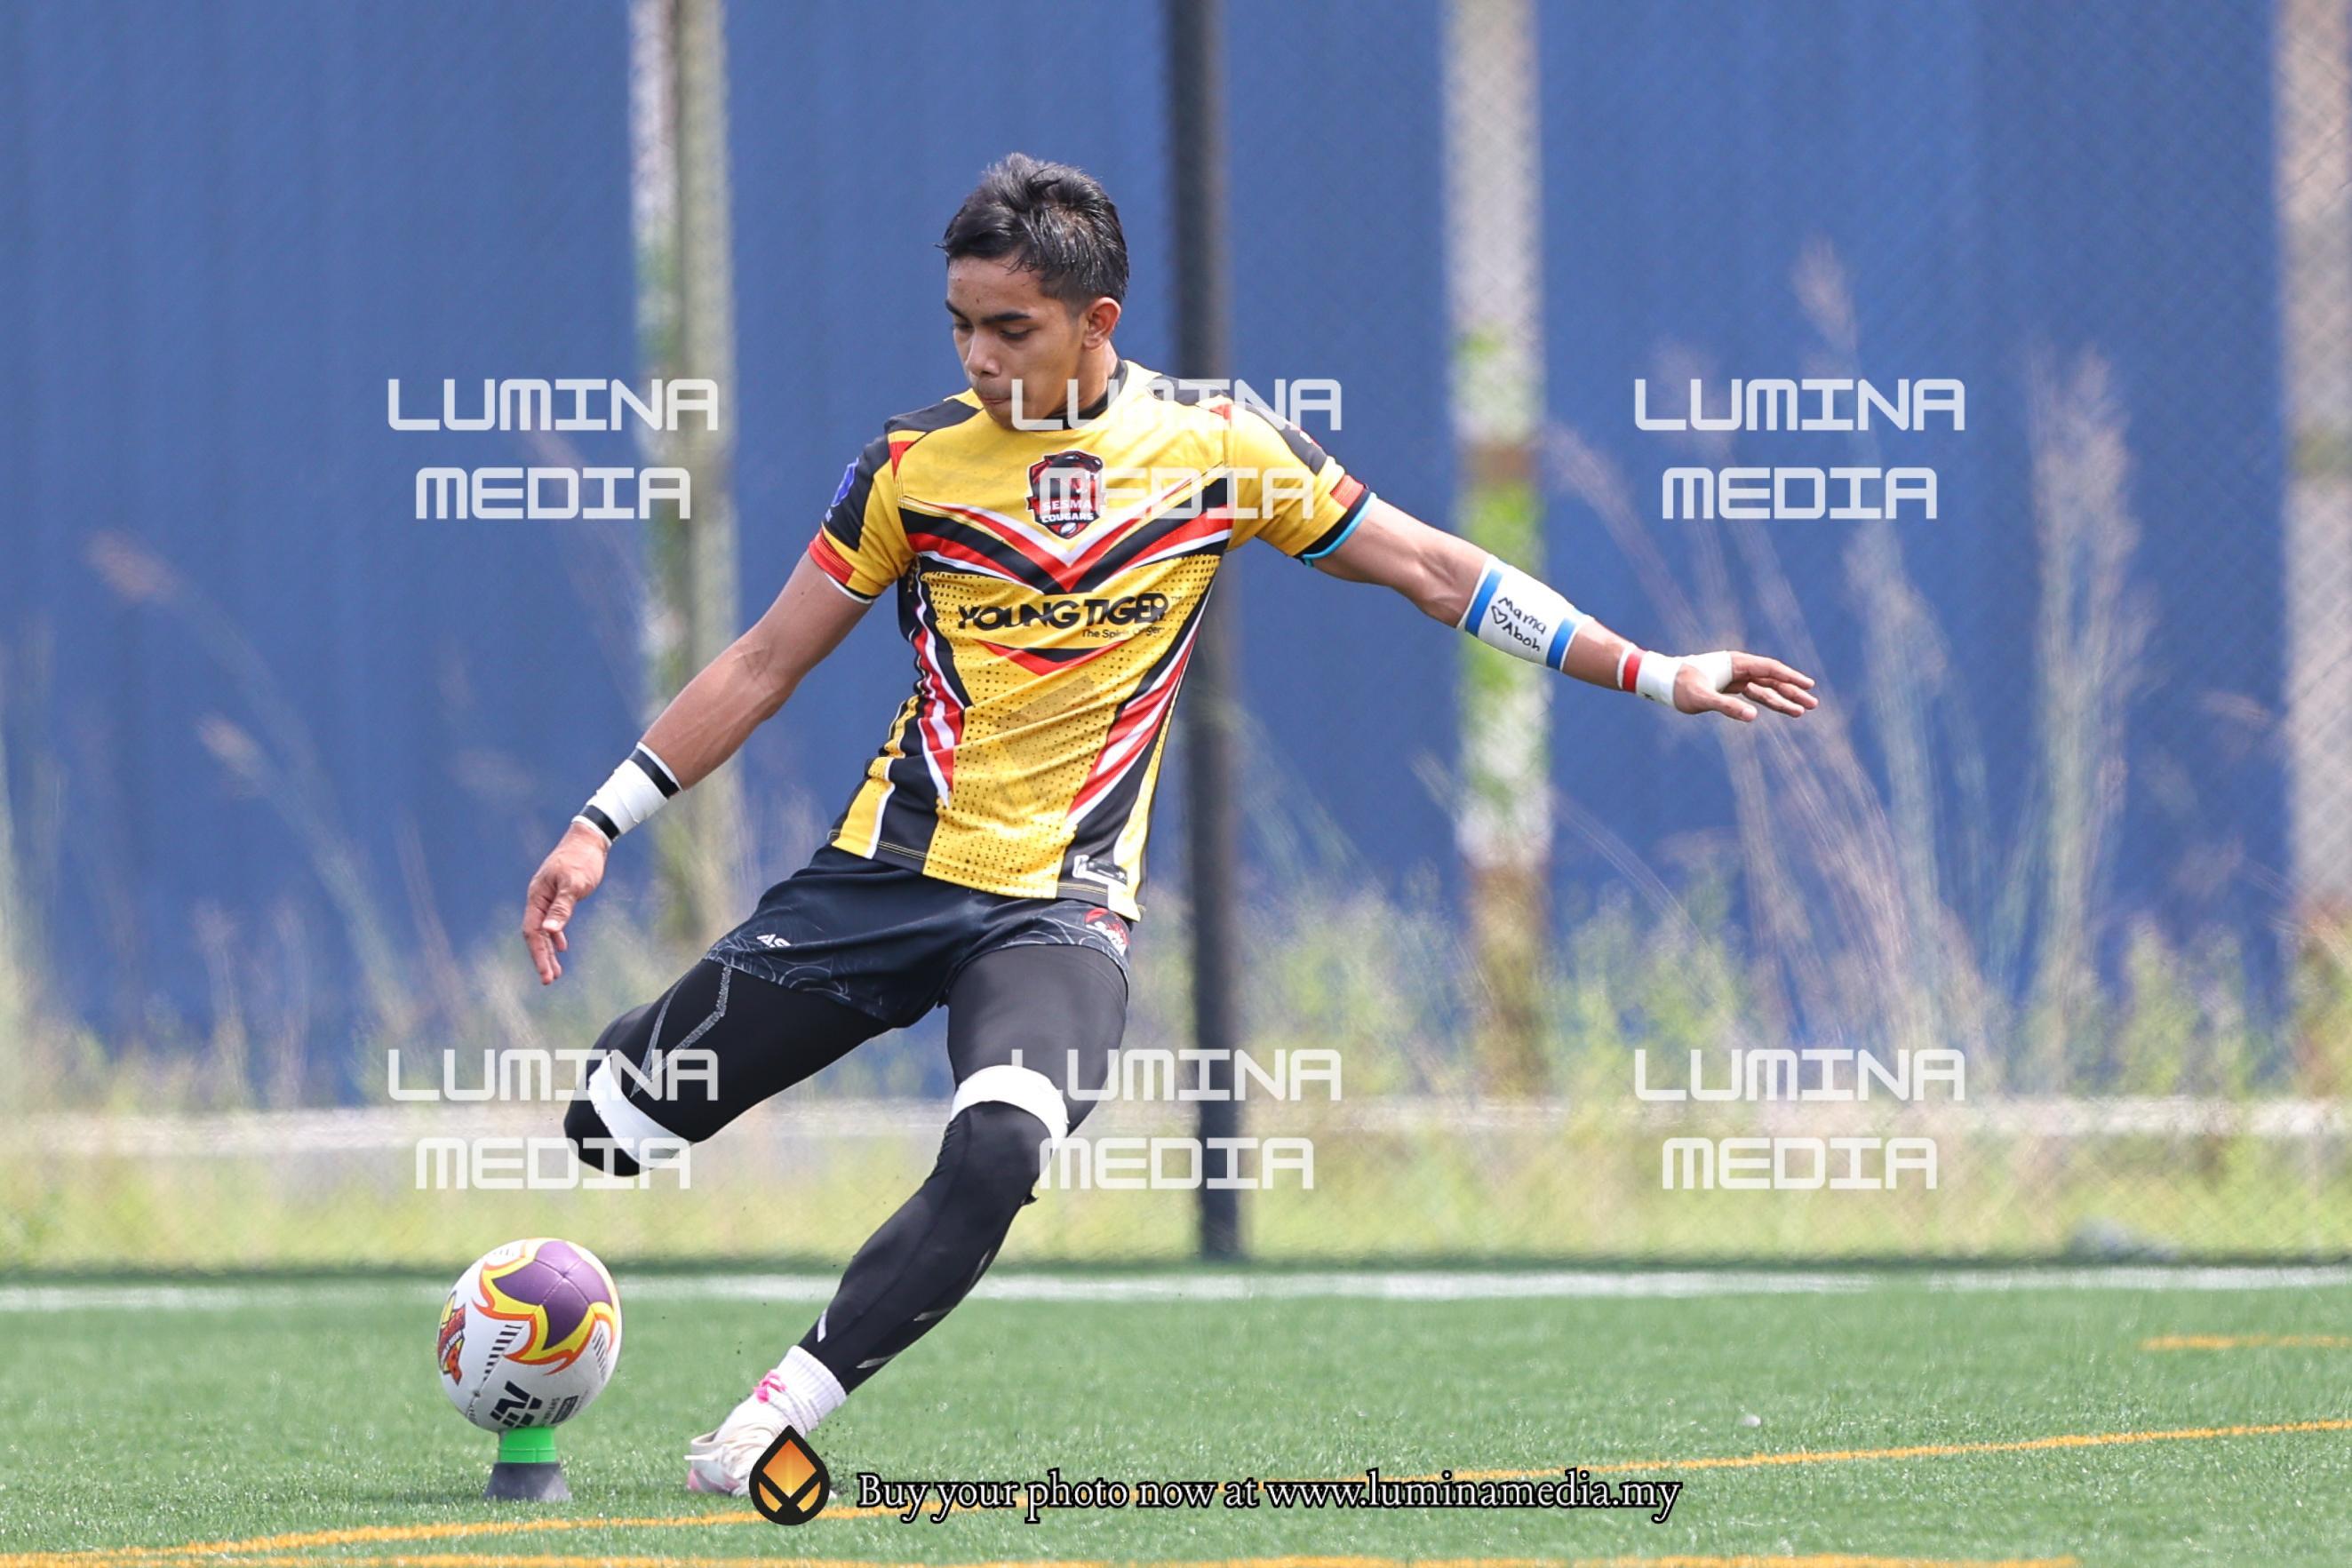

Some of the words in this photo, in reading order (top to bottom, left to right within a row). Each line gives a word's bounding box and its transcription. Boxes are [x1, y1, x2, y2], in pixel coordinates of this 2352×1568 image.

[1040, 512, 1095, 522] COUGARS
[1081, 628, 1101, 638] The
[1502, 621, 1541, 651] Aboh
